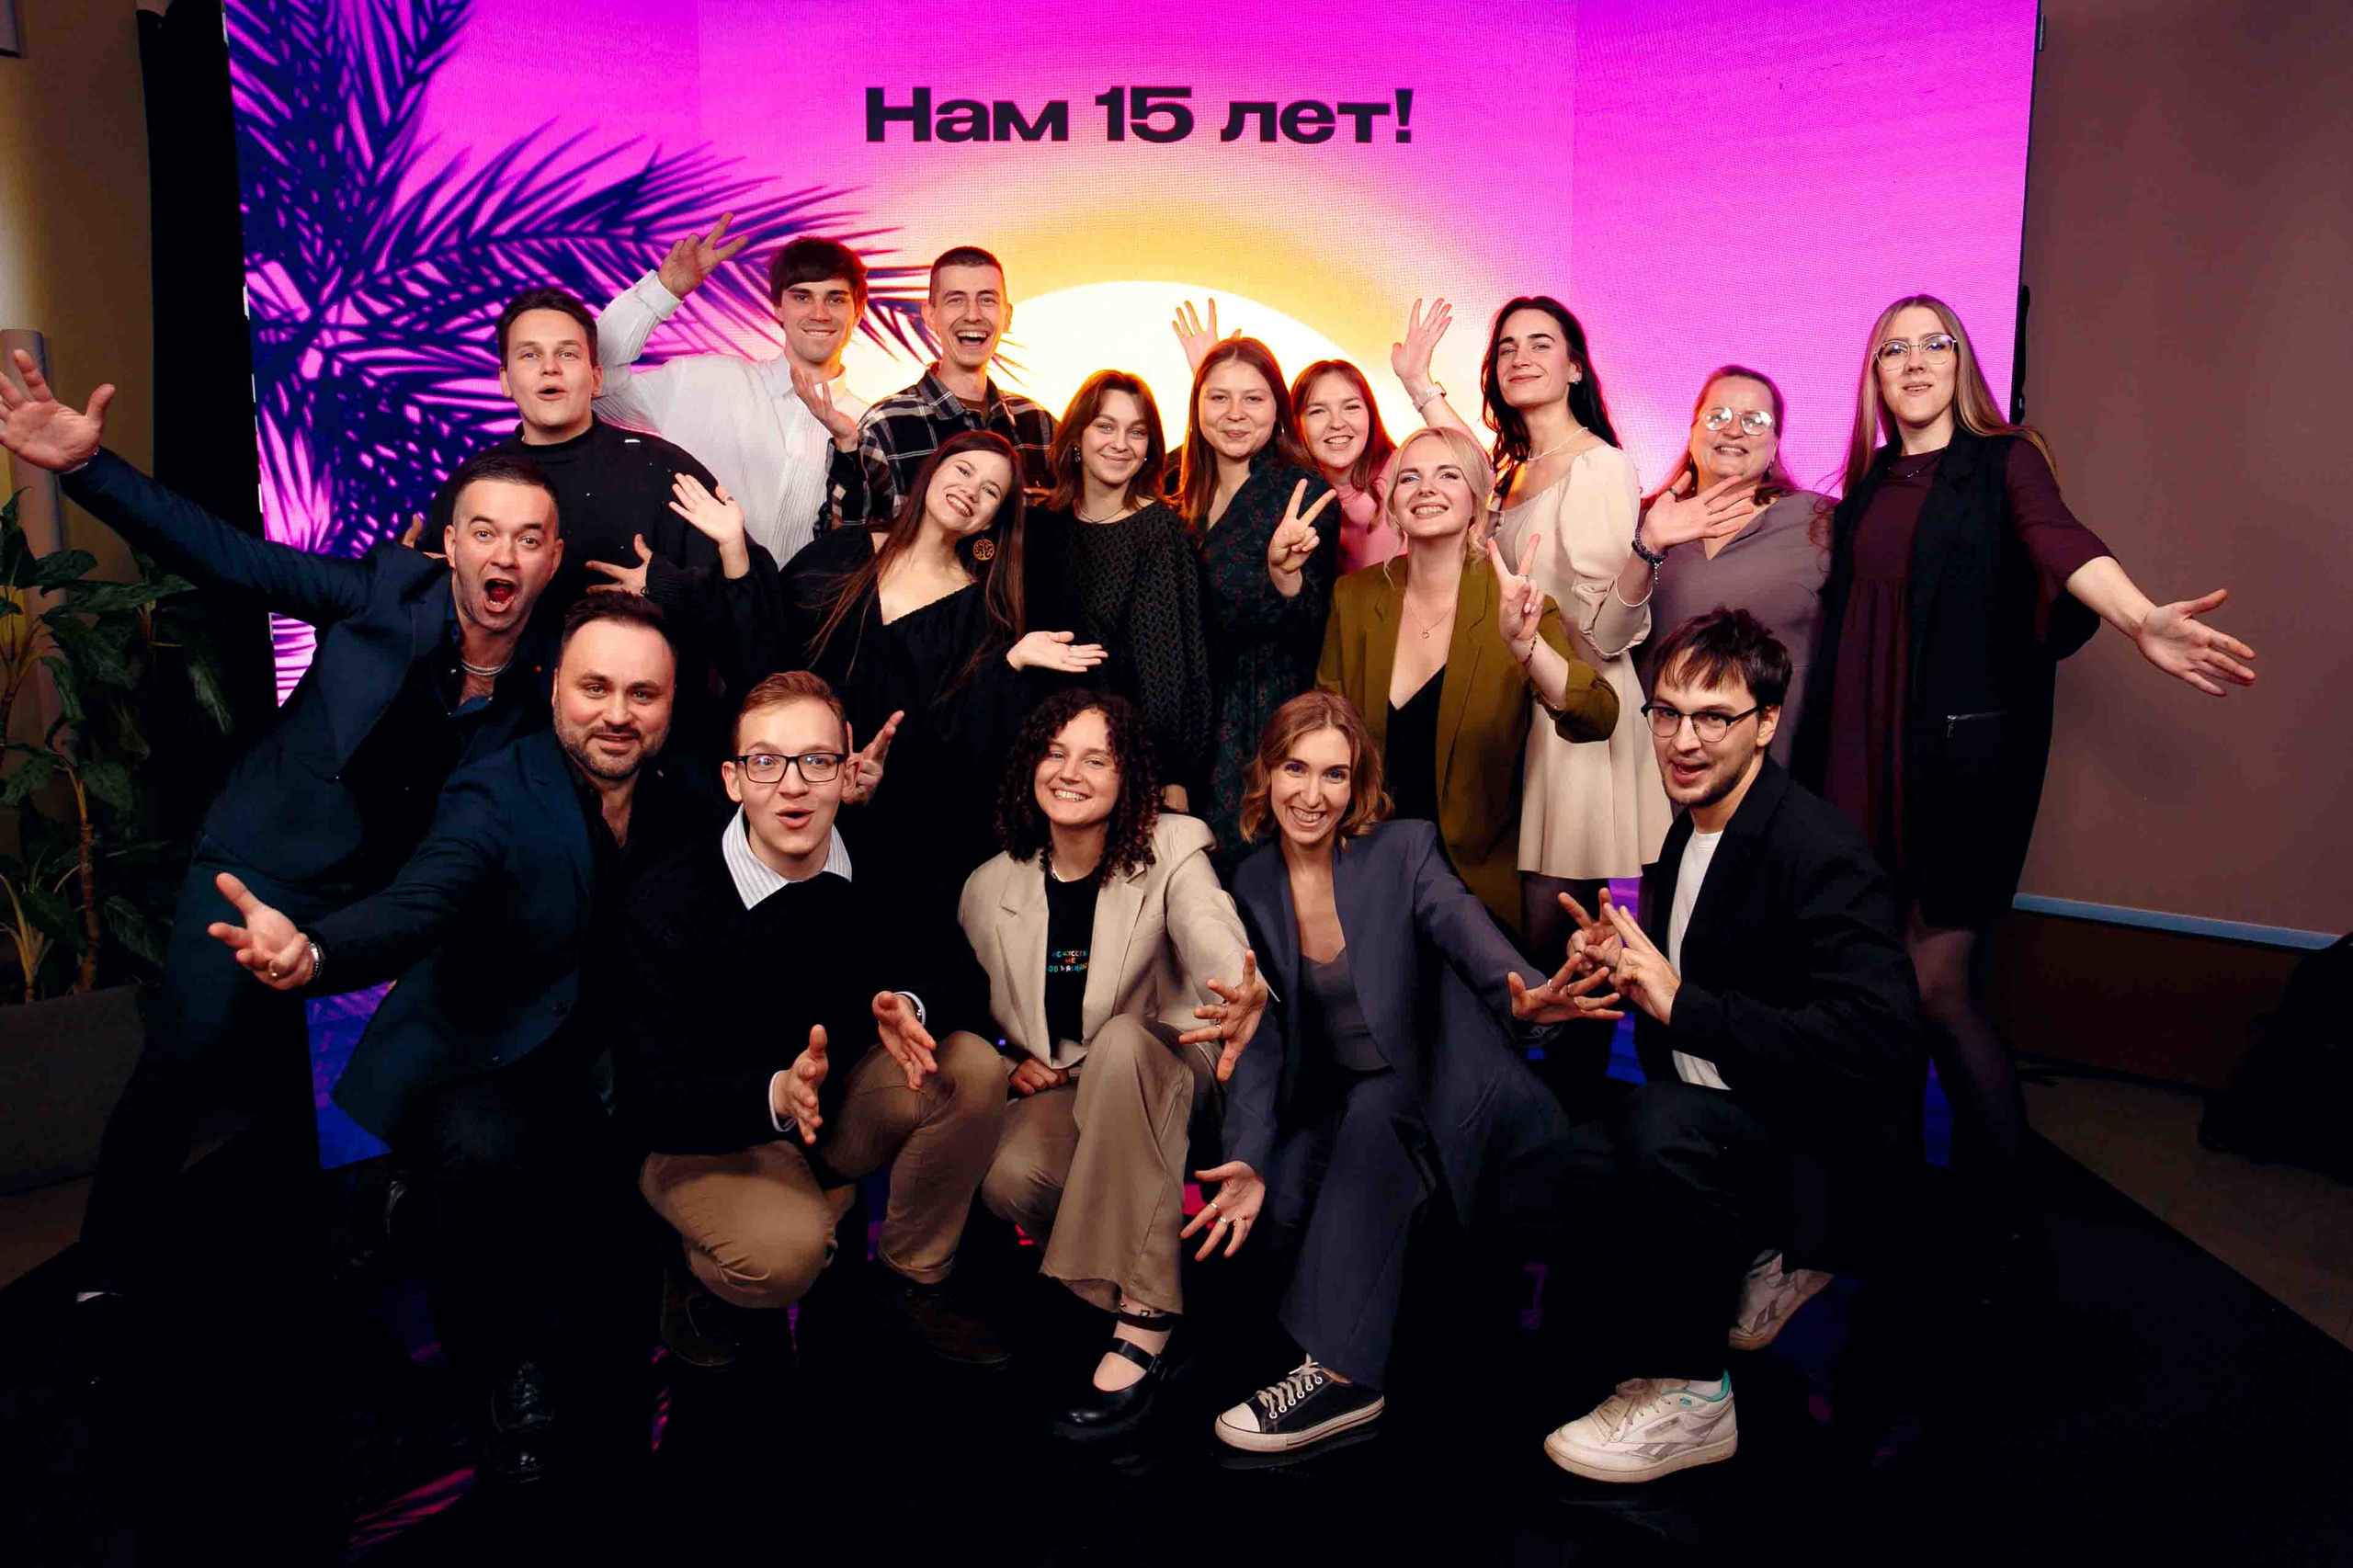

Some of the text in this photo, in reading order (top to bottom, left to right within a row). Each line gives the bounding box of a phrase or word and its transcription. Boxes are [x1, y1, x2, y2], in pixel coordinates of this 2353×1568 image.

[866, 86, 1414, 144] Нам 15 лет!
